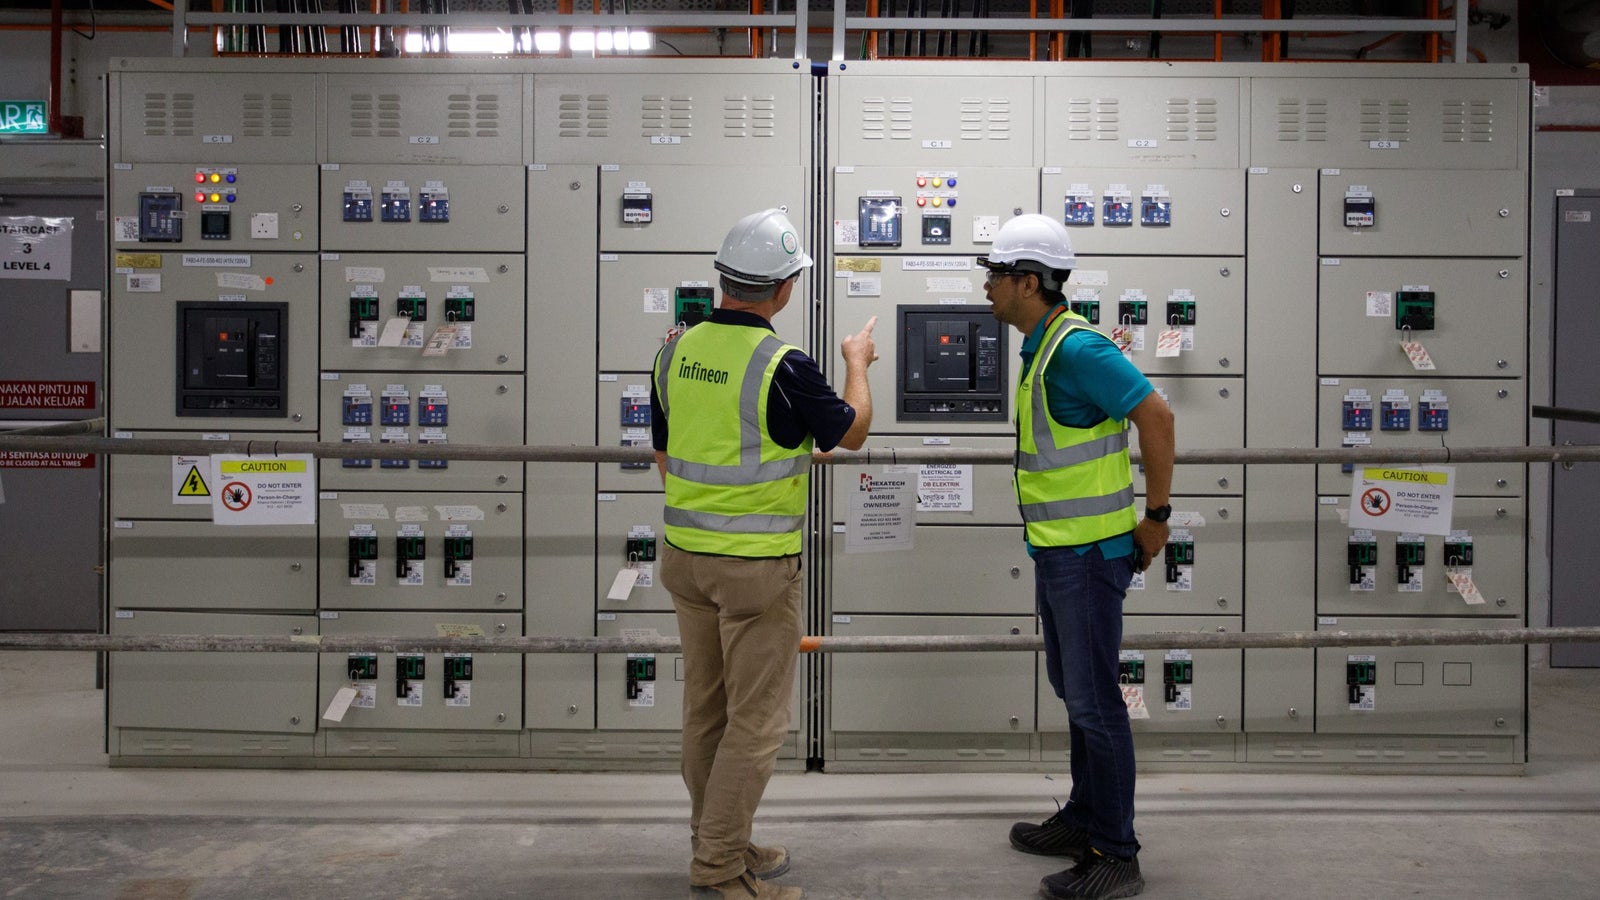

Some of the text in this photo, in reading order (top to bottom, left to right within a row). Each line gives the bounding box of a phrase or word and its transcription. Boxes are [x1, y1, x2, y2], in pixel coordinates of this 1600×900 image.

[0, 225, 60, 234] TAIRCASE
[22, 242, 32, 254] 3
[4, 262, 50, 270] LEVEL 4
[678, 356, 728, 384] infineon
[39, 384, 70, 394] PINTU
[74, 385, 88, 394] INI
[7, 396, 40, 406] JALAN
[44, 396, 85, 406] KELUAR
[240, 462, 287, 472] CAUTION
[1383, 471, 1428, 481] CAUTION
